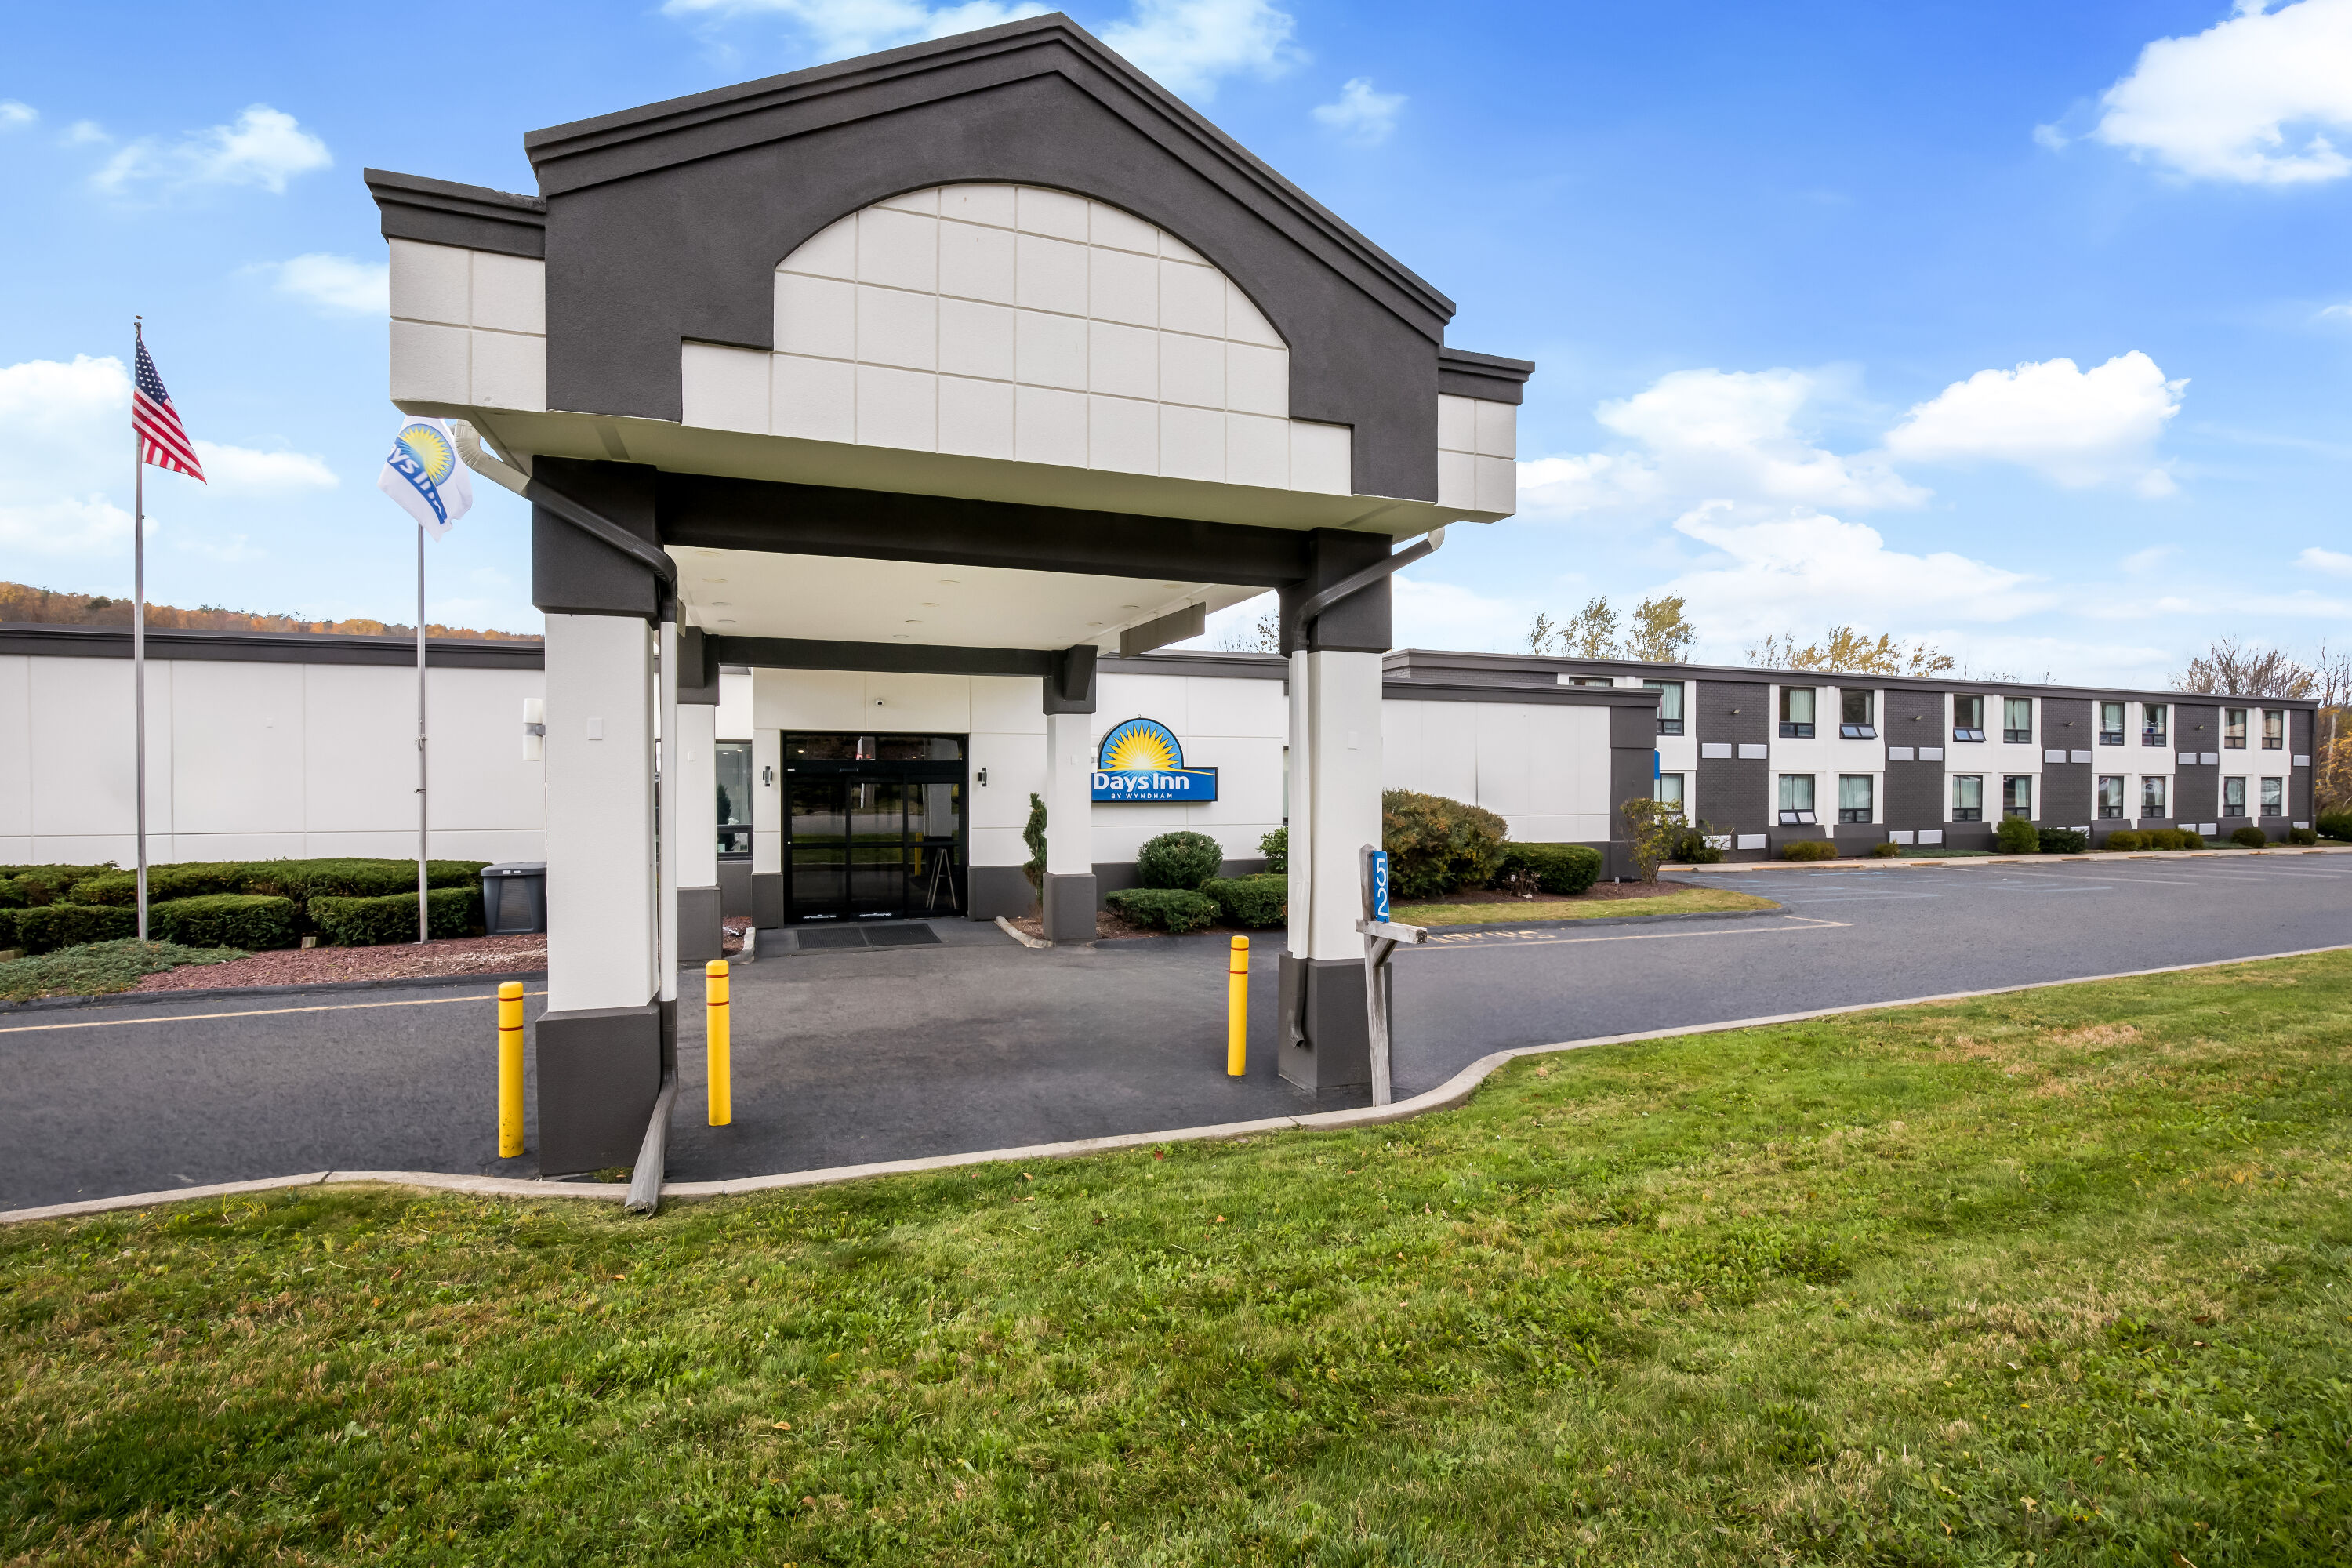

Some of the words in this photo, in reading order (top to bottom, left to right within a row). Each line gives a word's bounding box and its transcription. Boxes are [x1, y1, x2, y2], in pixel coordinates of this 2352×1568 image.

[1093, 773, 1149, 793] Days
[1153, 774, 1189, 790] Inn
[1376, 858, 1388, 917] 52
